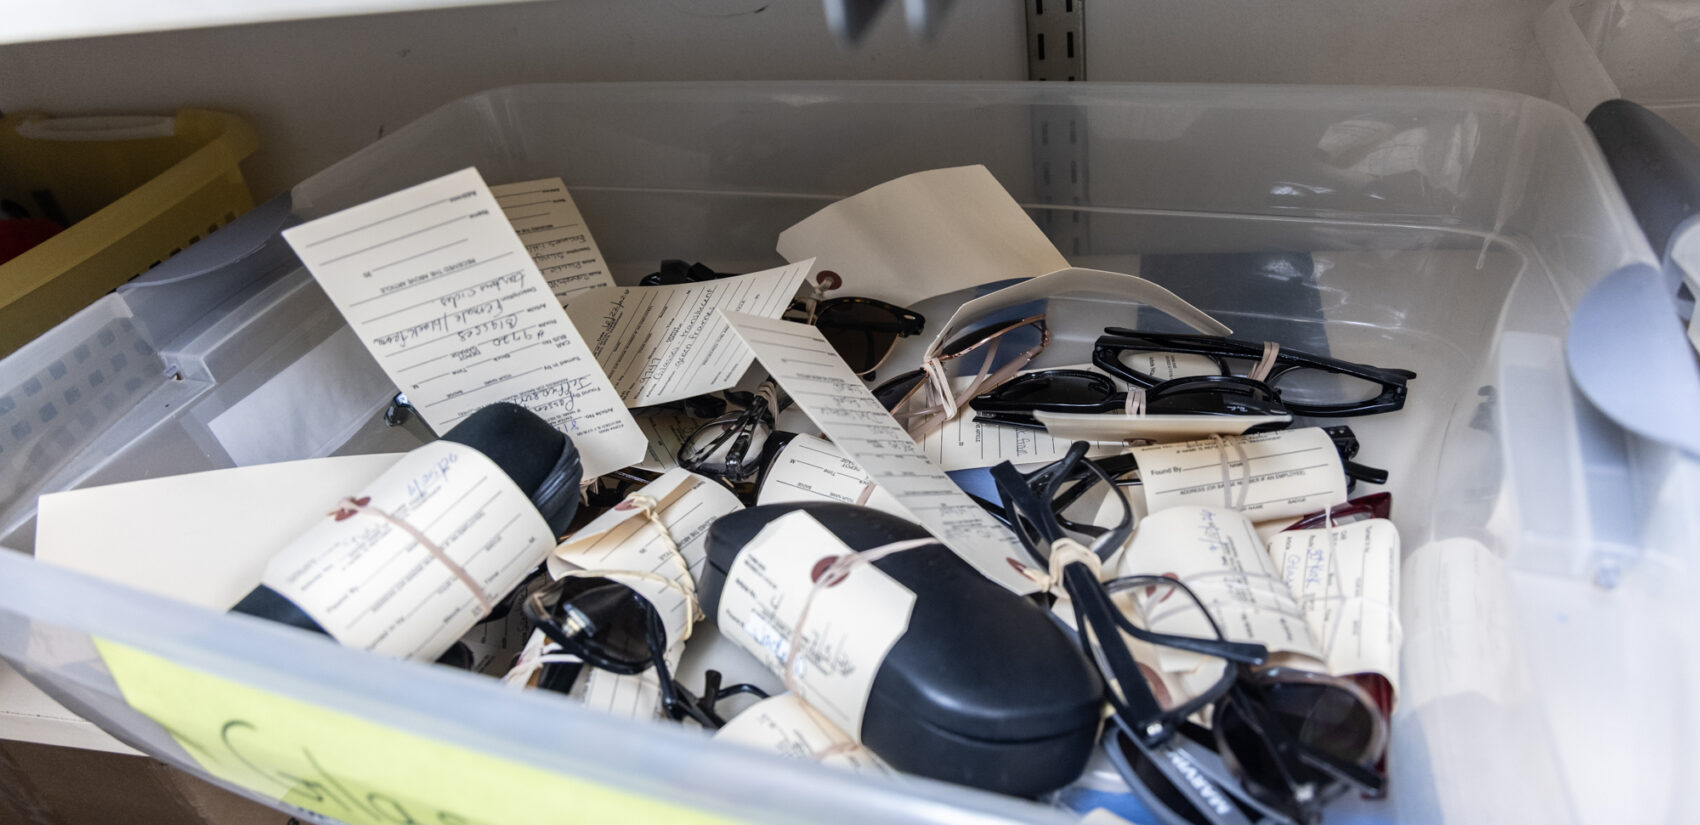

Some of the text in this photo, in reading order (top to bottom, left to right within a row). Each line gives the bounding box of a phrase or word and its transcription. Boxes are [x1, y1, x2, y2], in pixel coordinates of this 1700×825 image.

[678, 285, 714, 339] translucent
[1150, 465, 1182, 476] Found By
[1179, 486, 1205, 495] ADDRESS
